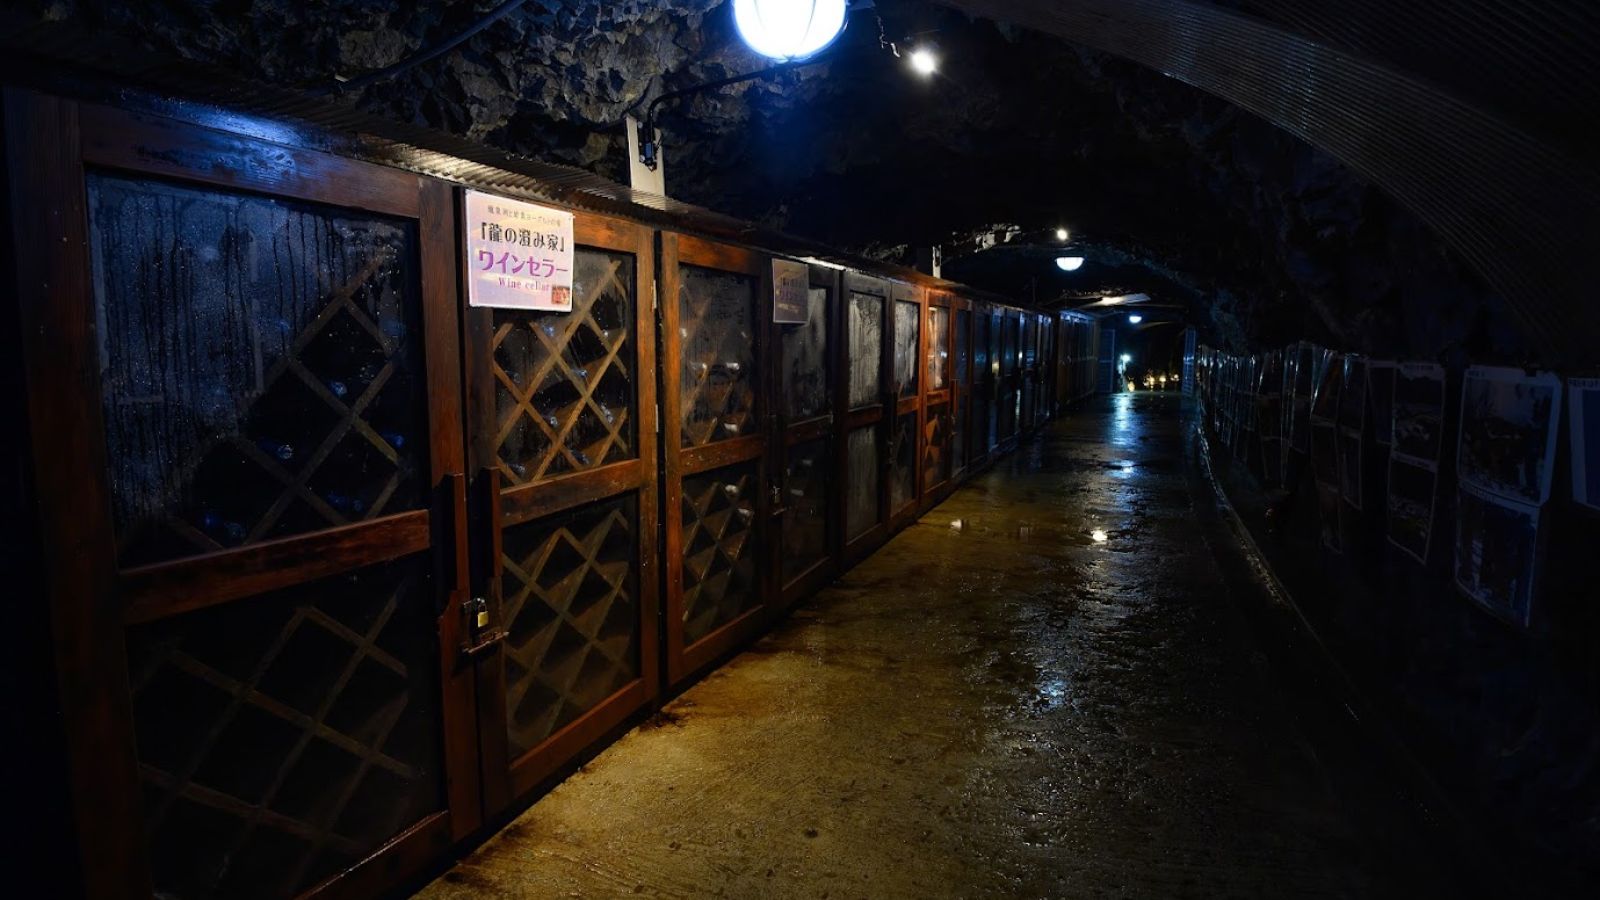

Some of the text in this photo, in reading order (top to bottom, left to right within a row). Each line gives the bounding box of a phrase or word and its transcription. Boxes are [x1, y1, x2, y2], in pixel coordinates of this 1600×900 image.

[479, 250, 568, 277] ワインセラー
[498, 278, 550, 291] Wine cellar
